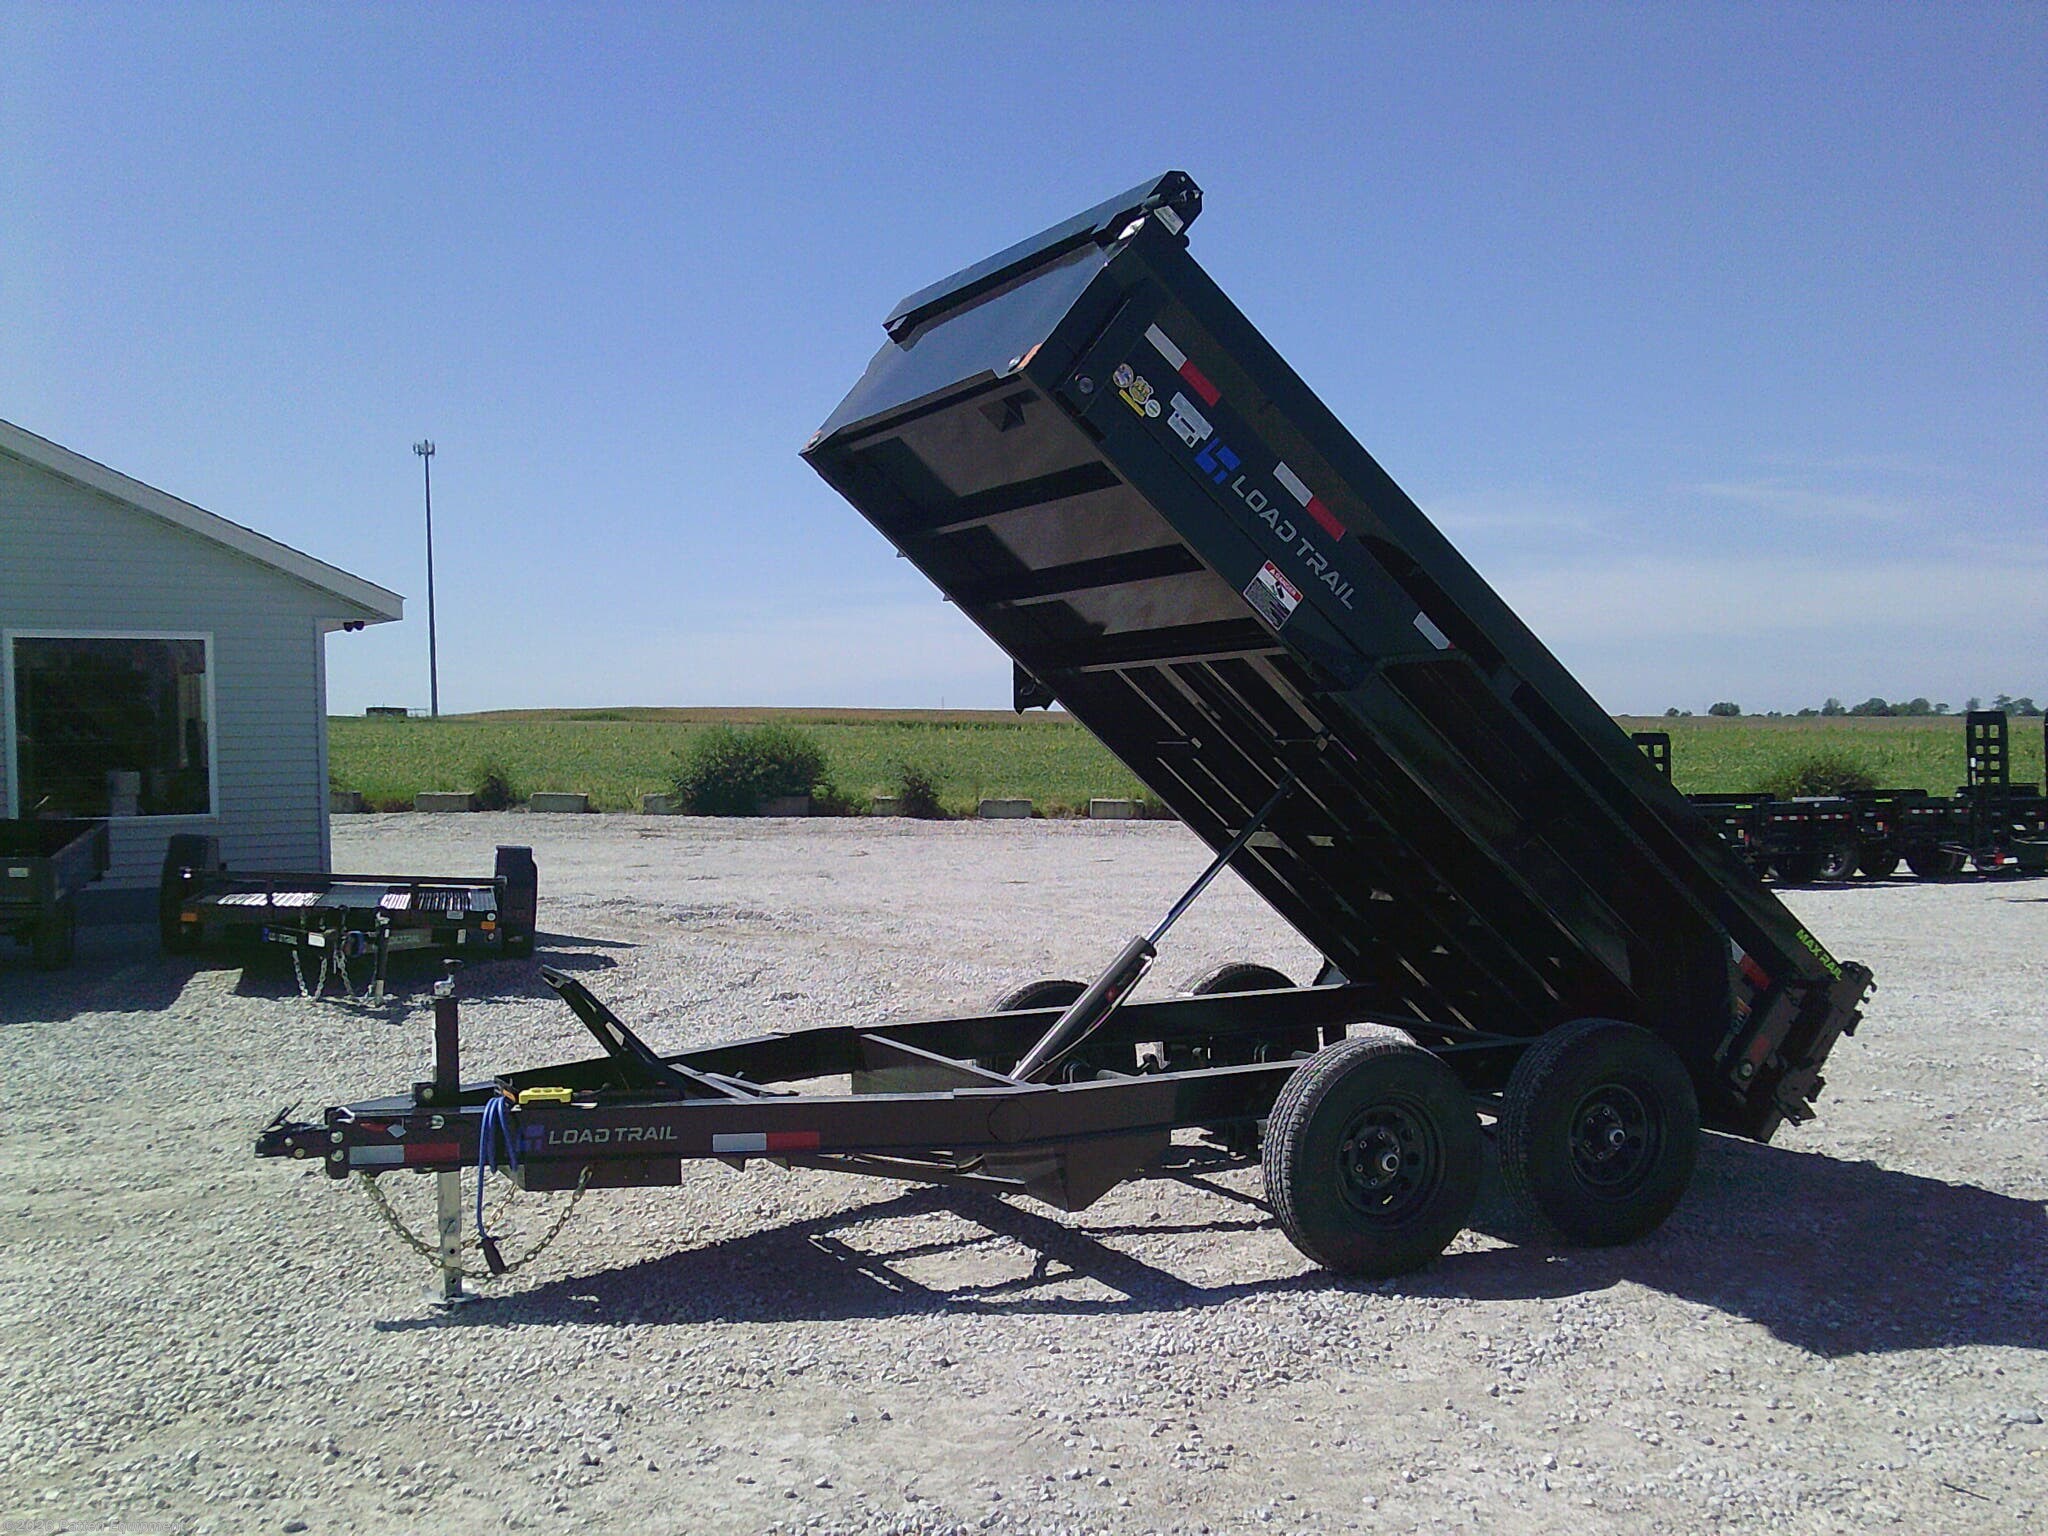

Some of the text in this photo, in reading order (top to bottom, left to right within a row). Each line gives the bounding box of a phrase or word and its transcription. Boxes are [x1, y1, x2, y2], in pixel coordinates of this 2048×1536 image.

[1231, 475, 1297, 543] LOAD
[1296, 537, 1354, 610] TRAIL
[1796, 929, 1843, 981] MAX RAIL
[548, 1126, 678, 1145] LOAD TRAIL
